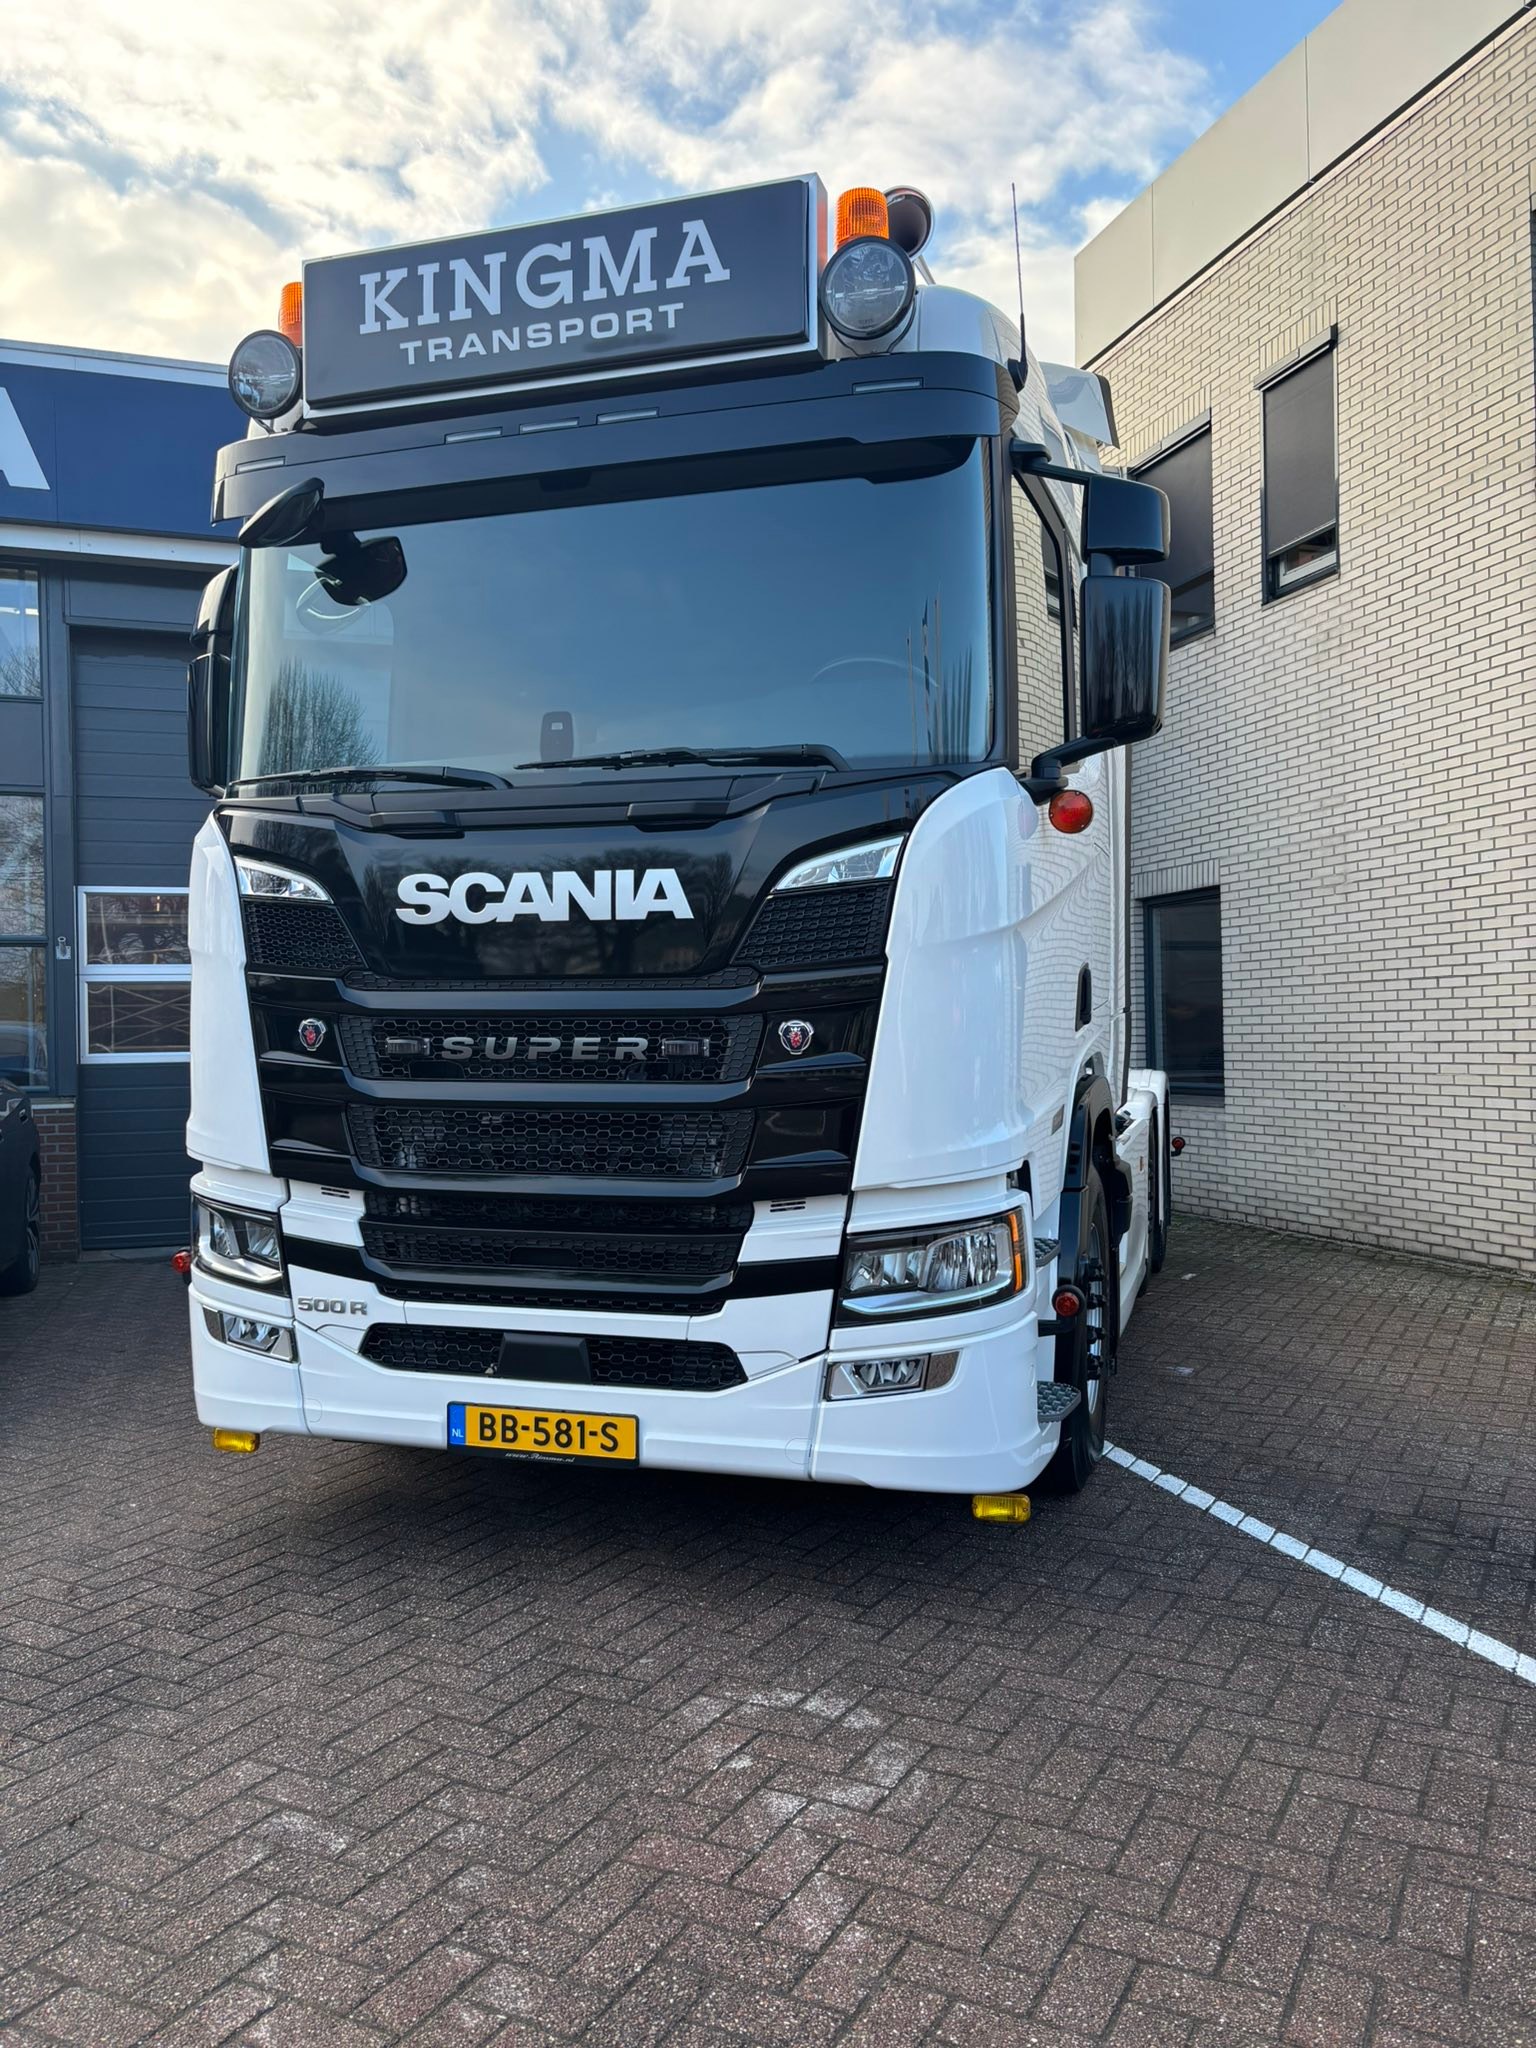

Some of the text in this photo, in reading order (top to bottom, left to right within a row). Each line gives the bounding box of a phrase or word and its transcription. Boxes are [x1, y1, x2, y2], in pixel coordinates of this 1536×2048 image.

[359, 219, 731, 335] KINGMA
[400, 303, 684, 365] TRANSPORT
[395, 868, 695, 925] SCANIA
[441, 1036, 649, 1060] SUPER
[297, 1297, 368, 1316] 500 R
[452, 1412, 619, 1453] NL BB-581-S
